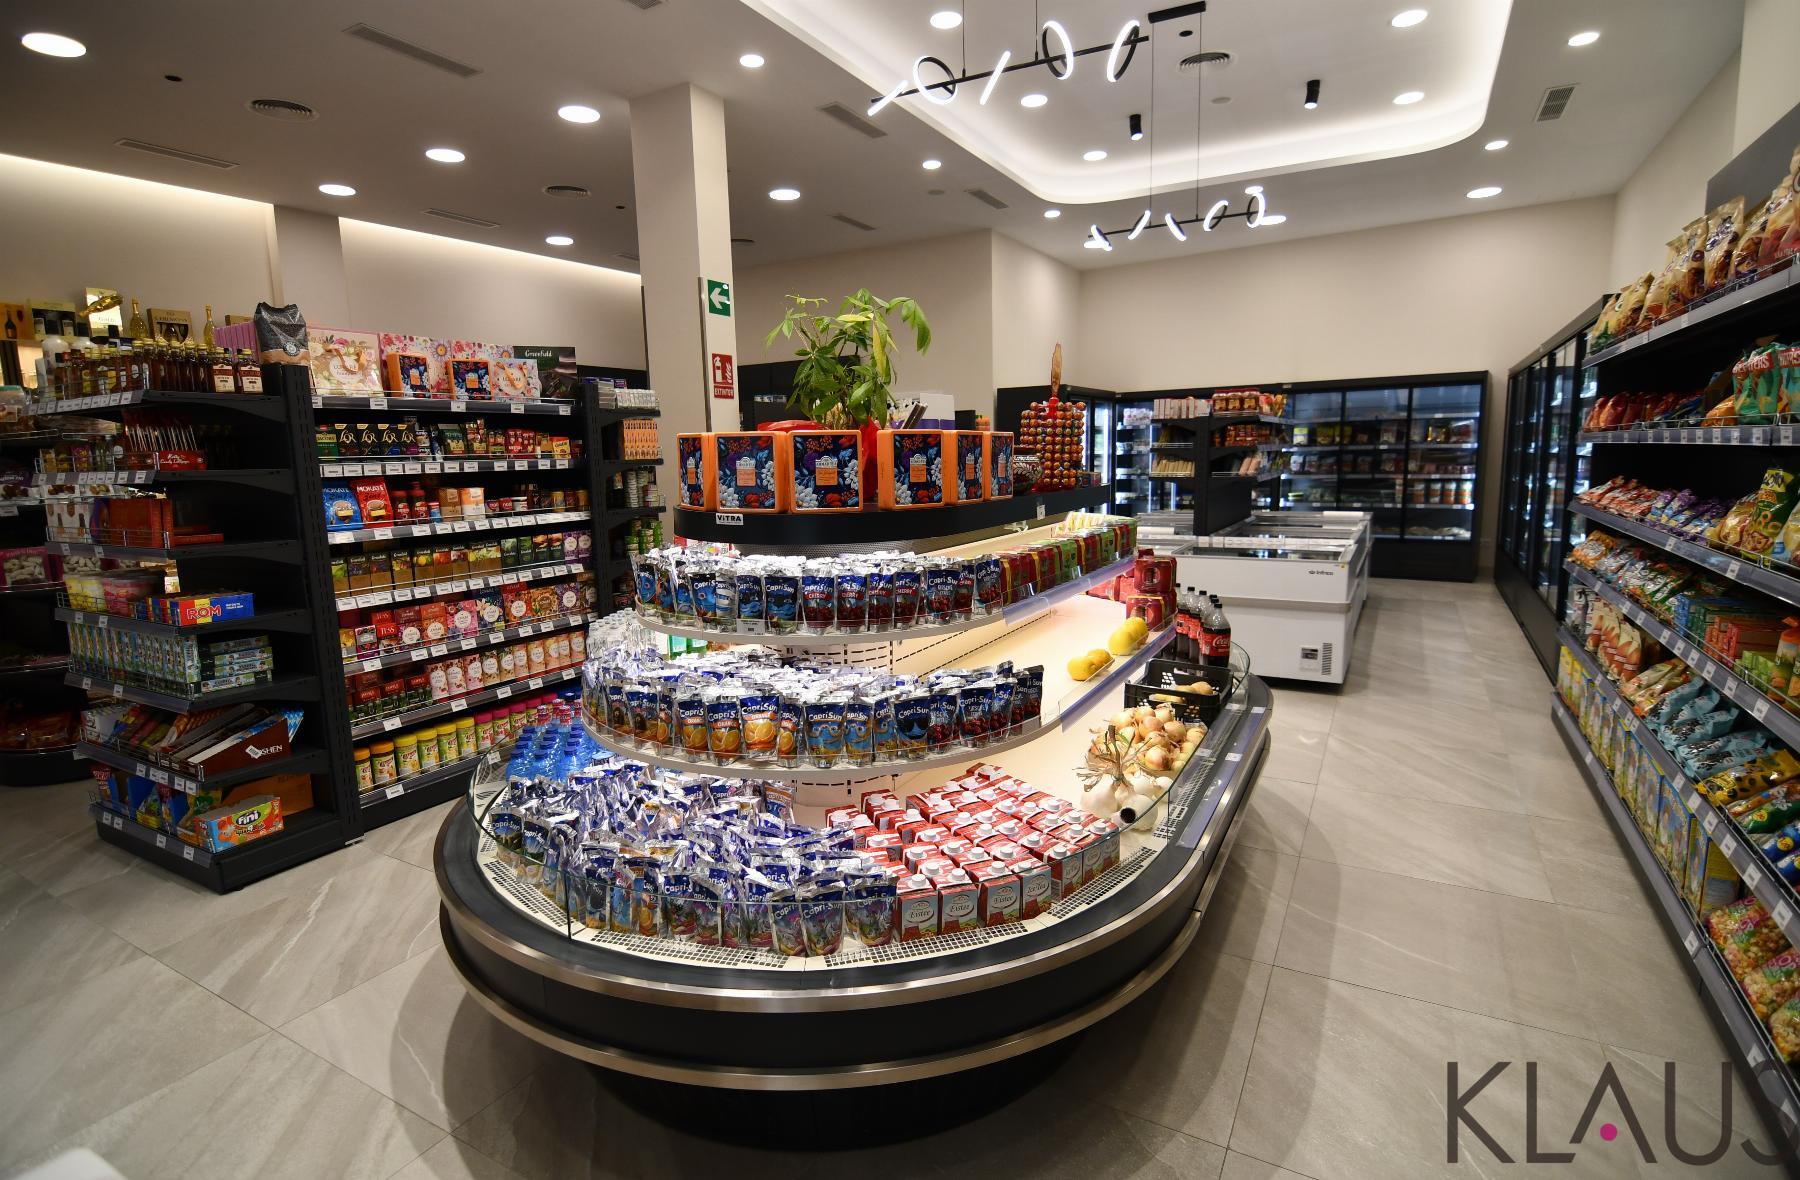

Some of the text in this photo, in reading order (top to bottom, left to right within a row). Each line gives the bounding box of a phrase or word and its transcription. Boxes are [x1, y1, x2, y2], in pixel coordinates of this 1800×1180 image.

[714, 388, 734, 397] EXTINTOR
[187, 604, 222, 620] ROM
[381, 627, 395, 635] TESS
[259, 745, 283, 757] SHEN
